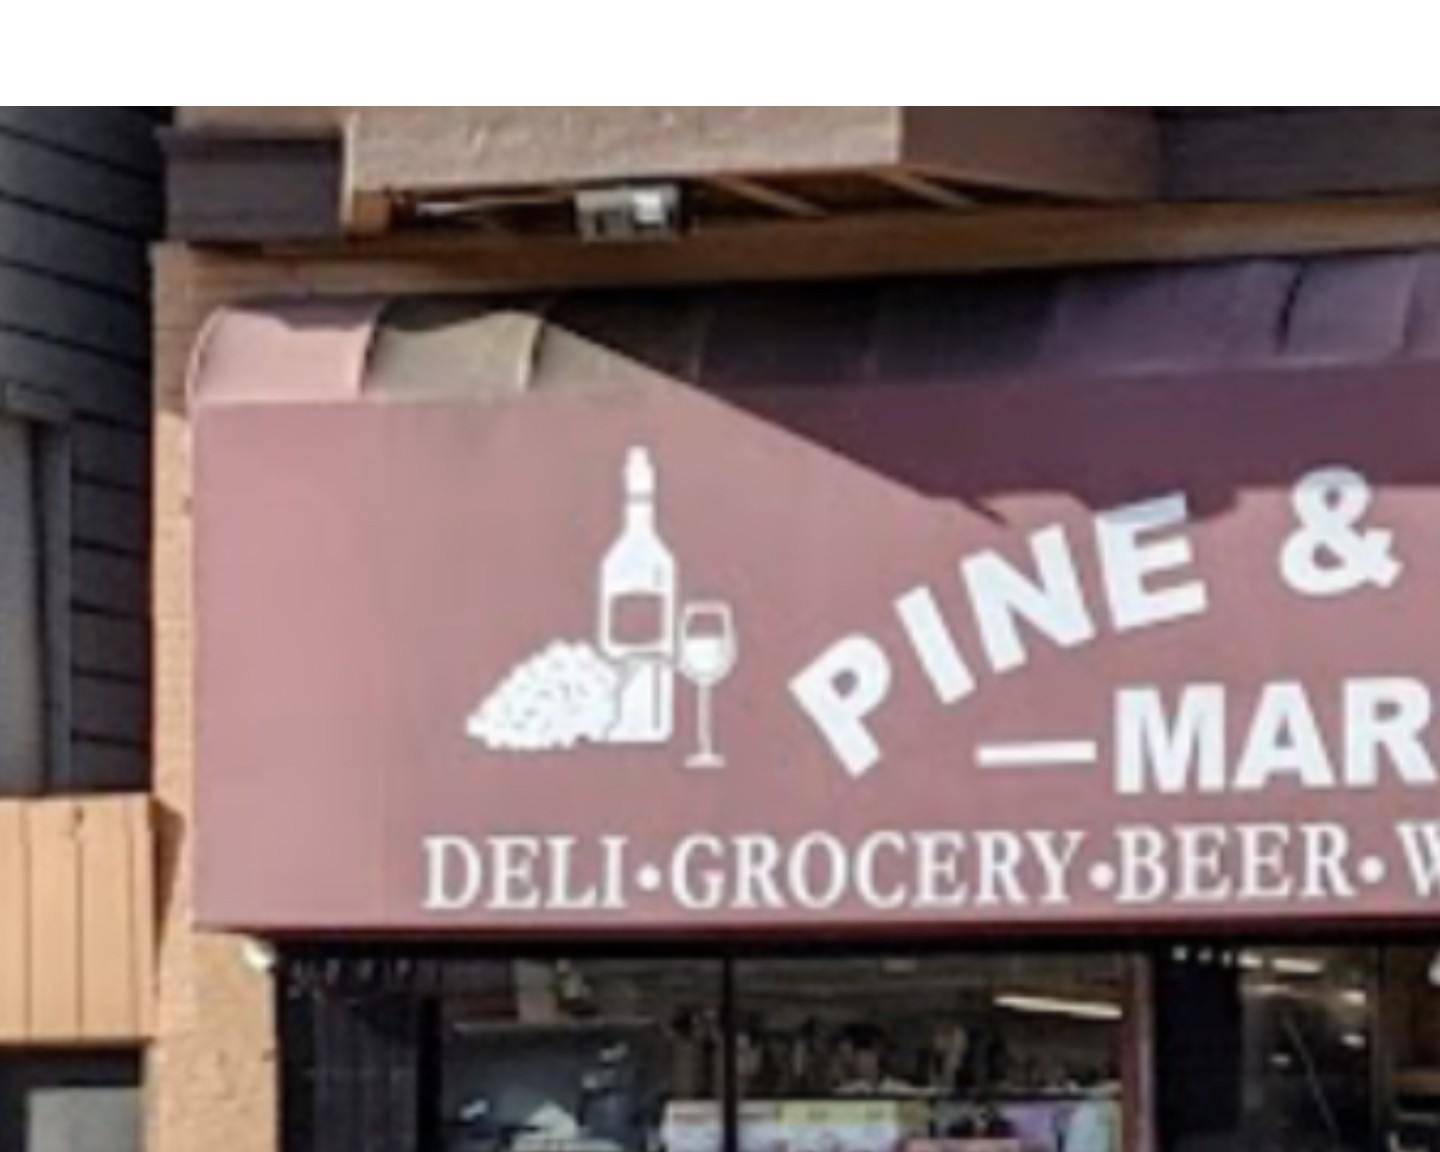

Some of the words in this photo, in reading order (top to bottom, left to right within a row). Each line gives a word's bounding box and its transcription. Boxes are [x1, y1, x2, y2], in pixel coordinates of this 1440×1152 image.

[787, 493, 1209, 778] PINE
[1278, 468, 1402, 597] &
[423, 834, 627, 911] DELI
[669, 829, 1085, 910] GROCERY
[1115, 821, 1356, 904] BEER
